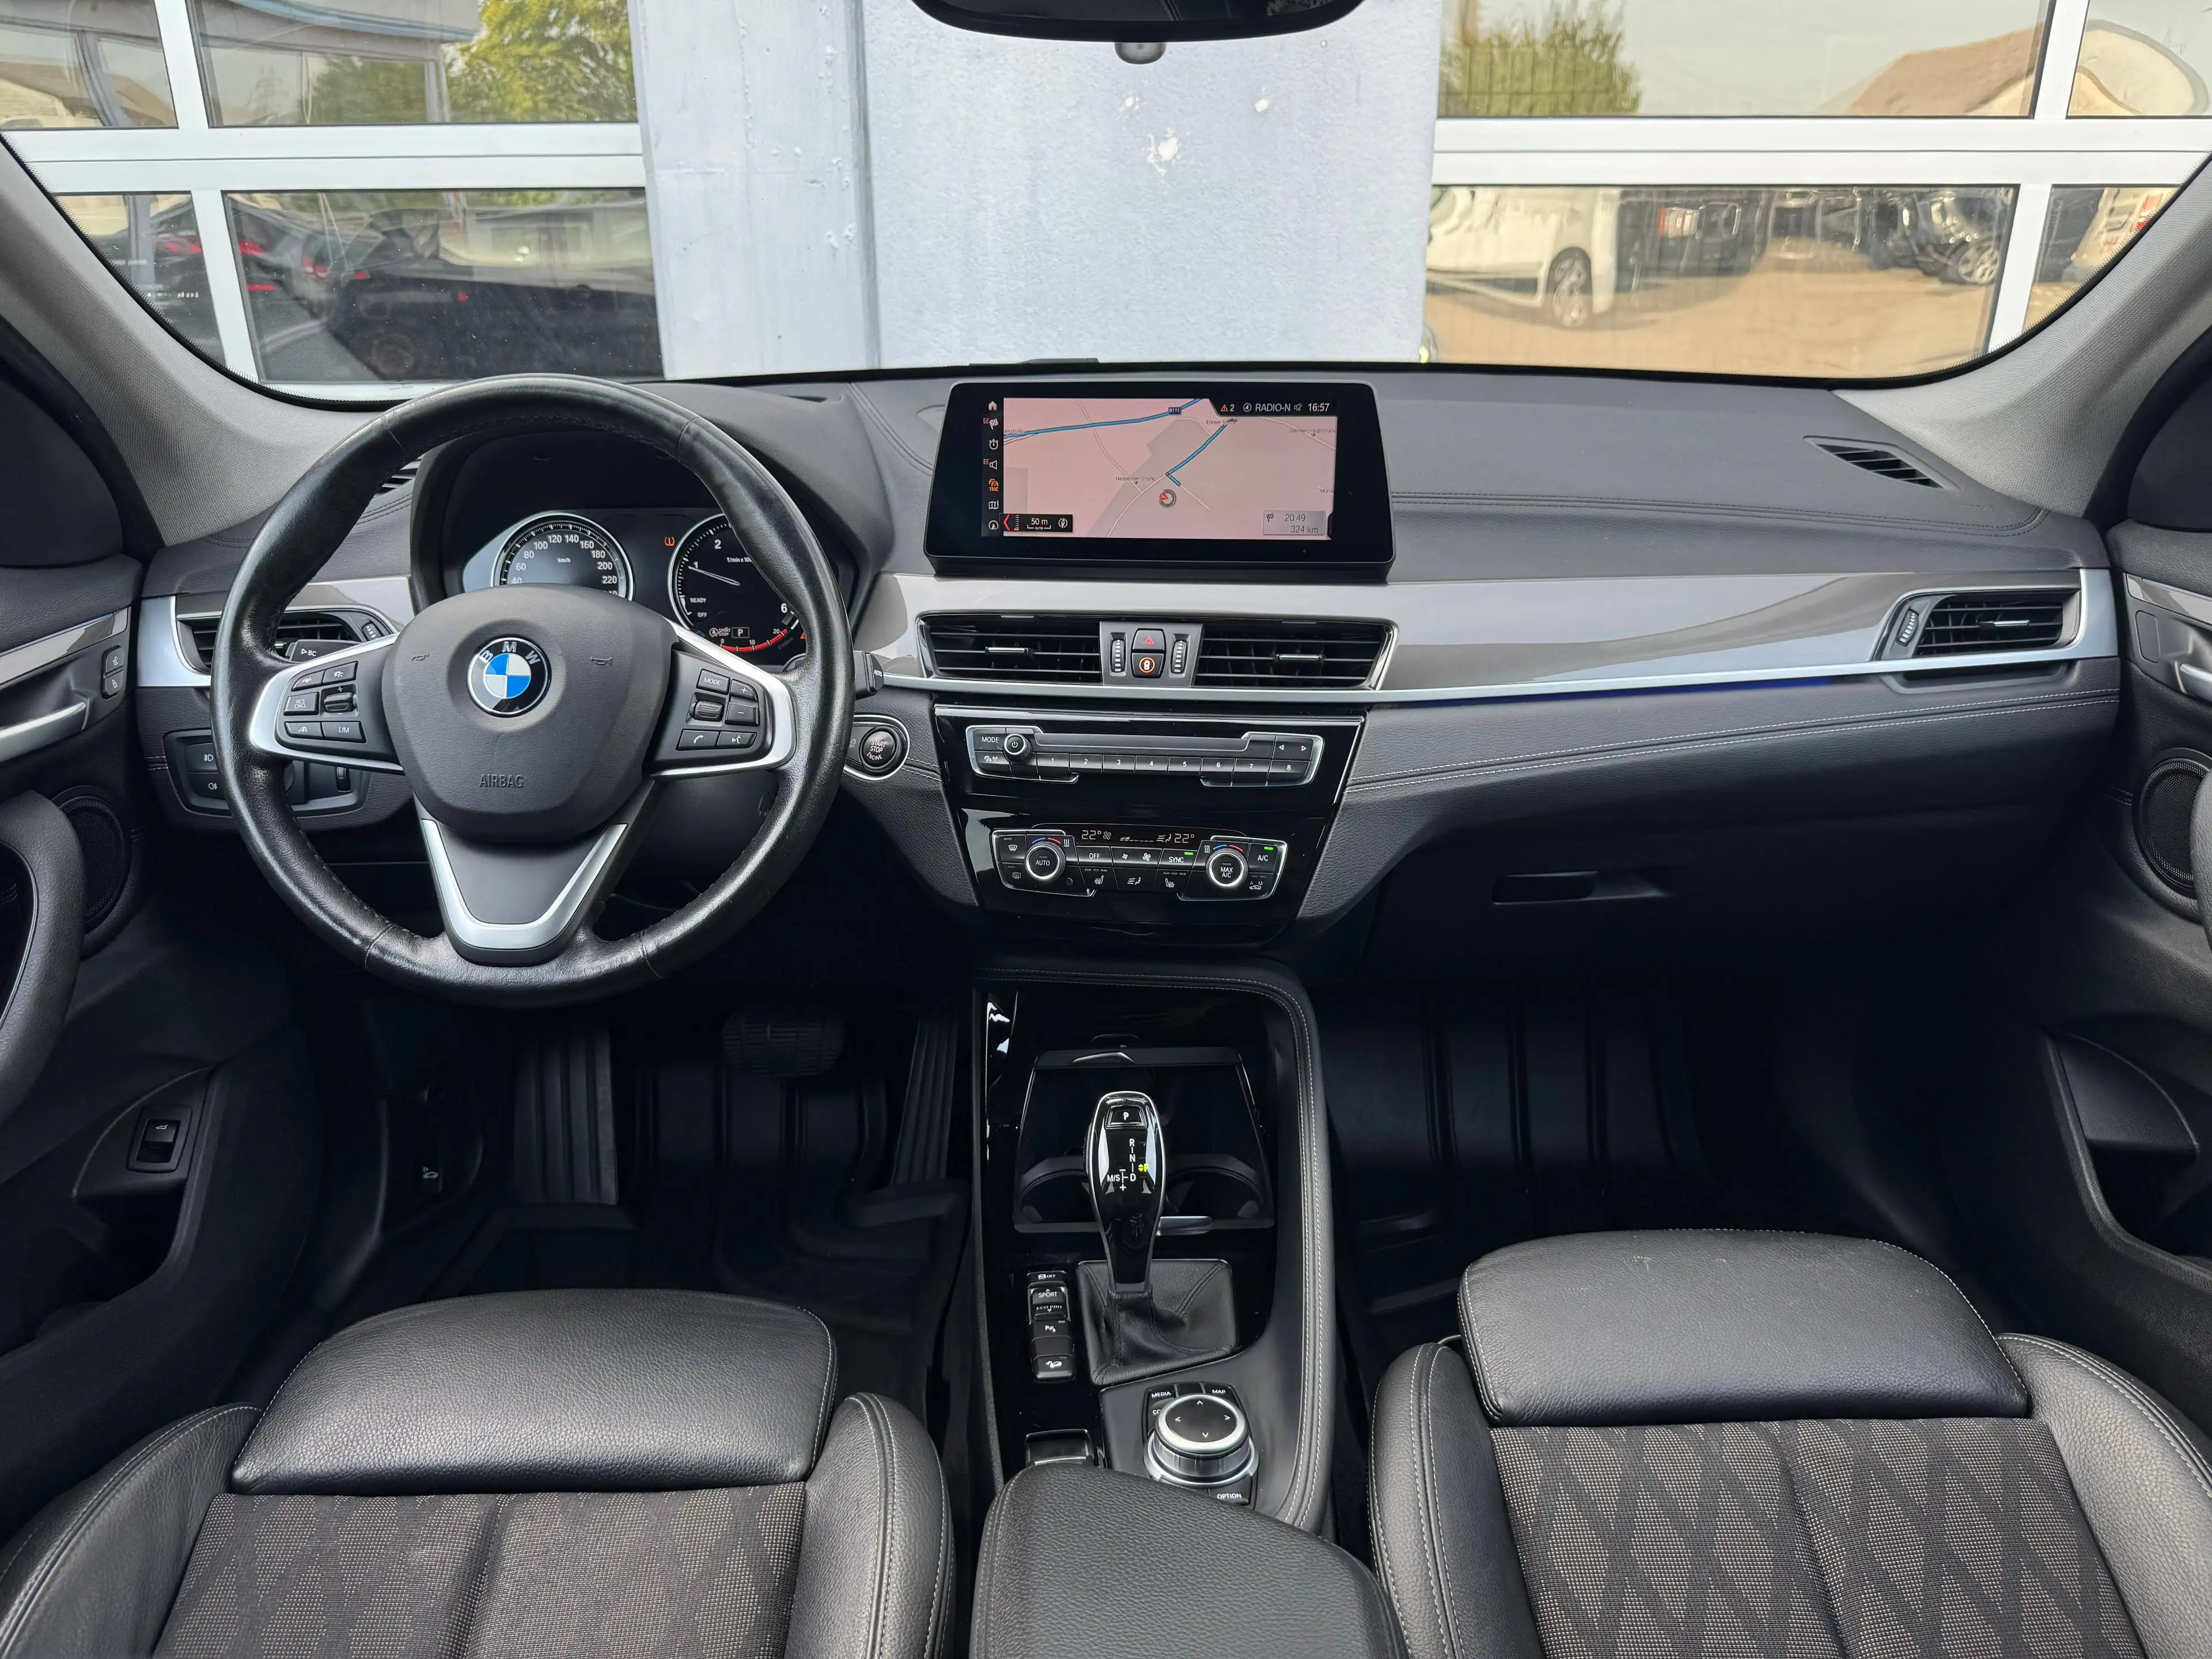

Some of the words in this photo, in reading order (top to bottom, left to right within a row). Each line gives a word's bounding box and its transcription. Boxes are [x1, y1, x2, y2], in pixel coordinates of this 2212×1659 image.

[1255, 404, 1290, 412] RADIO-N
[1308, 404, 1330, 412] 16:57
[548, 535, 562, 543] 120
[565, 534, 579, 543] 140
[533, 541, 548, 550] 100
[580, 540, 594, 549] 160
[714, 539, 721, 549] 2
[524, 551, 535, 559] 80
[591, 550, 605, 559] 180
[516, 562, 526, 571] 60
[597, 562, 612, 570] 200
[601, 575, 617, 584] 220
[781, 603, 787, 613] 6
[479, 641, 541, 664] BMW
[703, 677, 722, 686] MODE
[871, 740, 887, 748] START
[866, 752, 883, 760] ENGINE
[479, 774, 524, 788] AIRBAG
[1081, 830, 1101, 840] 22°
[1174, 834, 1195, 843] 22°
[1123, 1112, 1129, 1120] P
[1129, 1138, 1135, 1146] R
[1130, 1154, 1135, 1162] N
[1107, 1174, 1120, 1183] M/S
[1130, 1173, 1137, 1181] D
